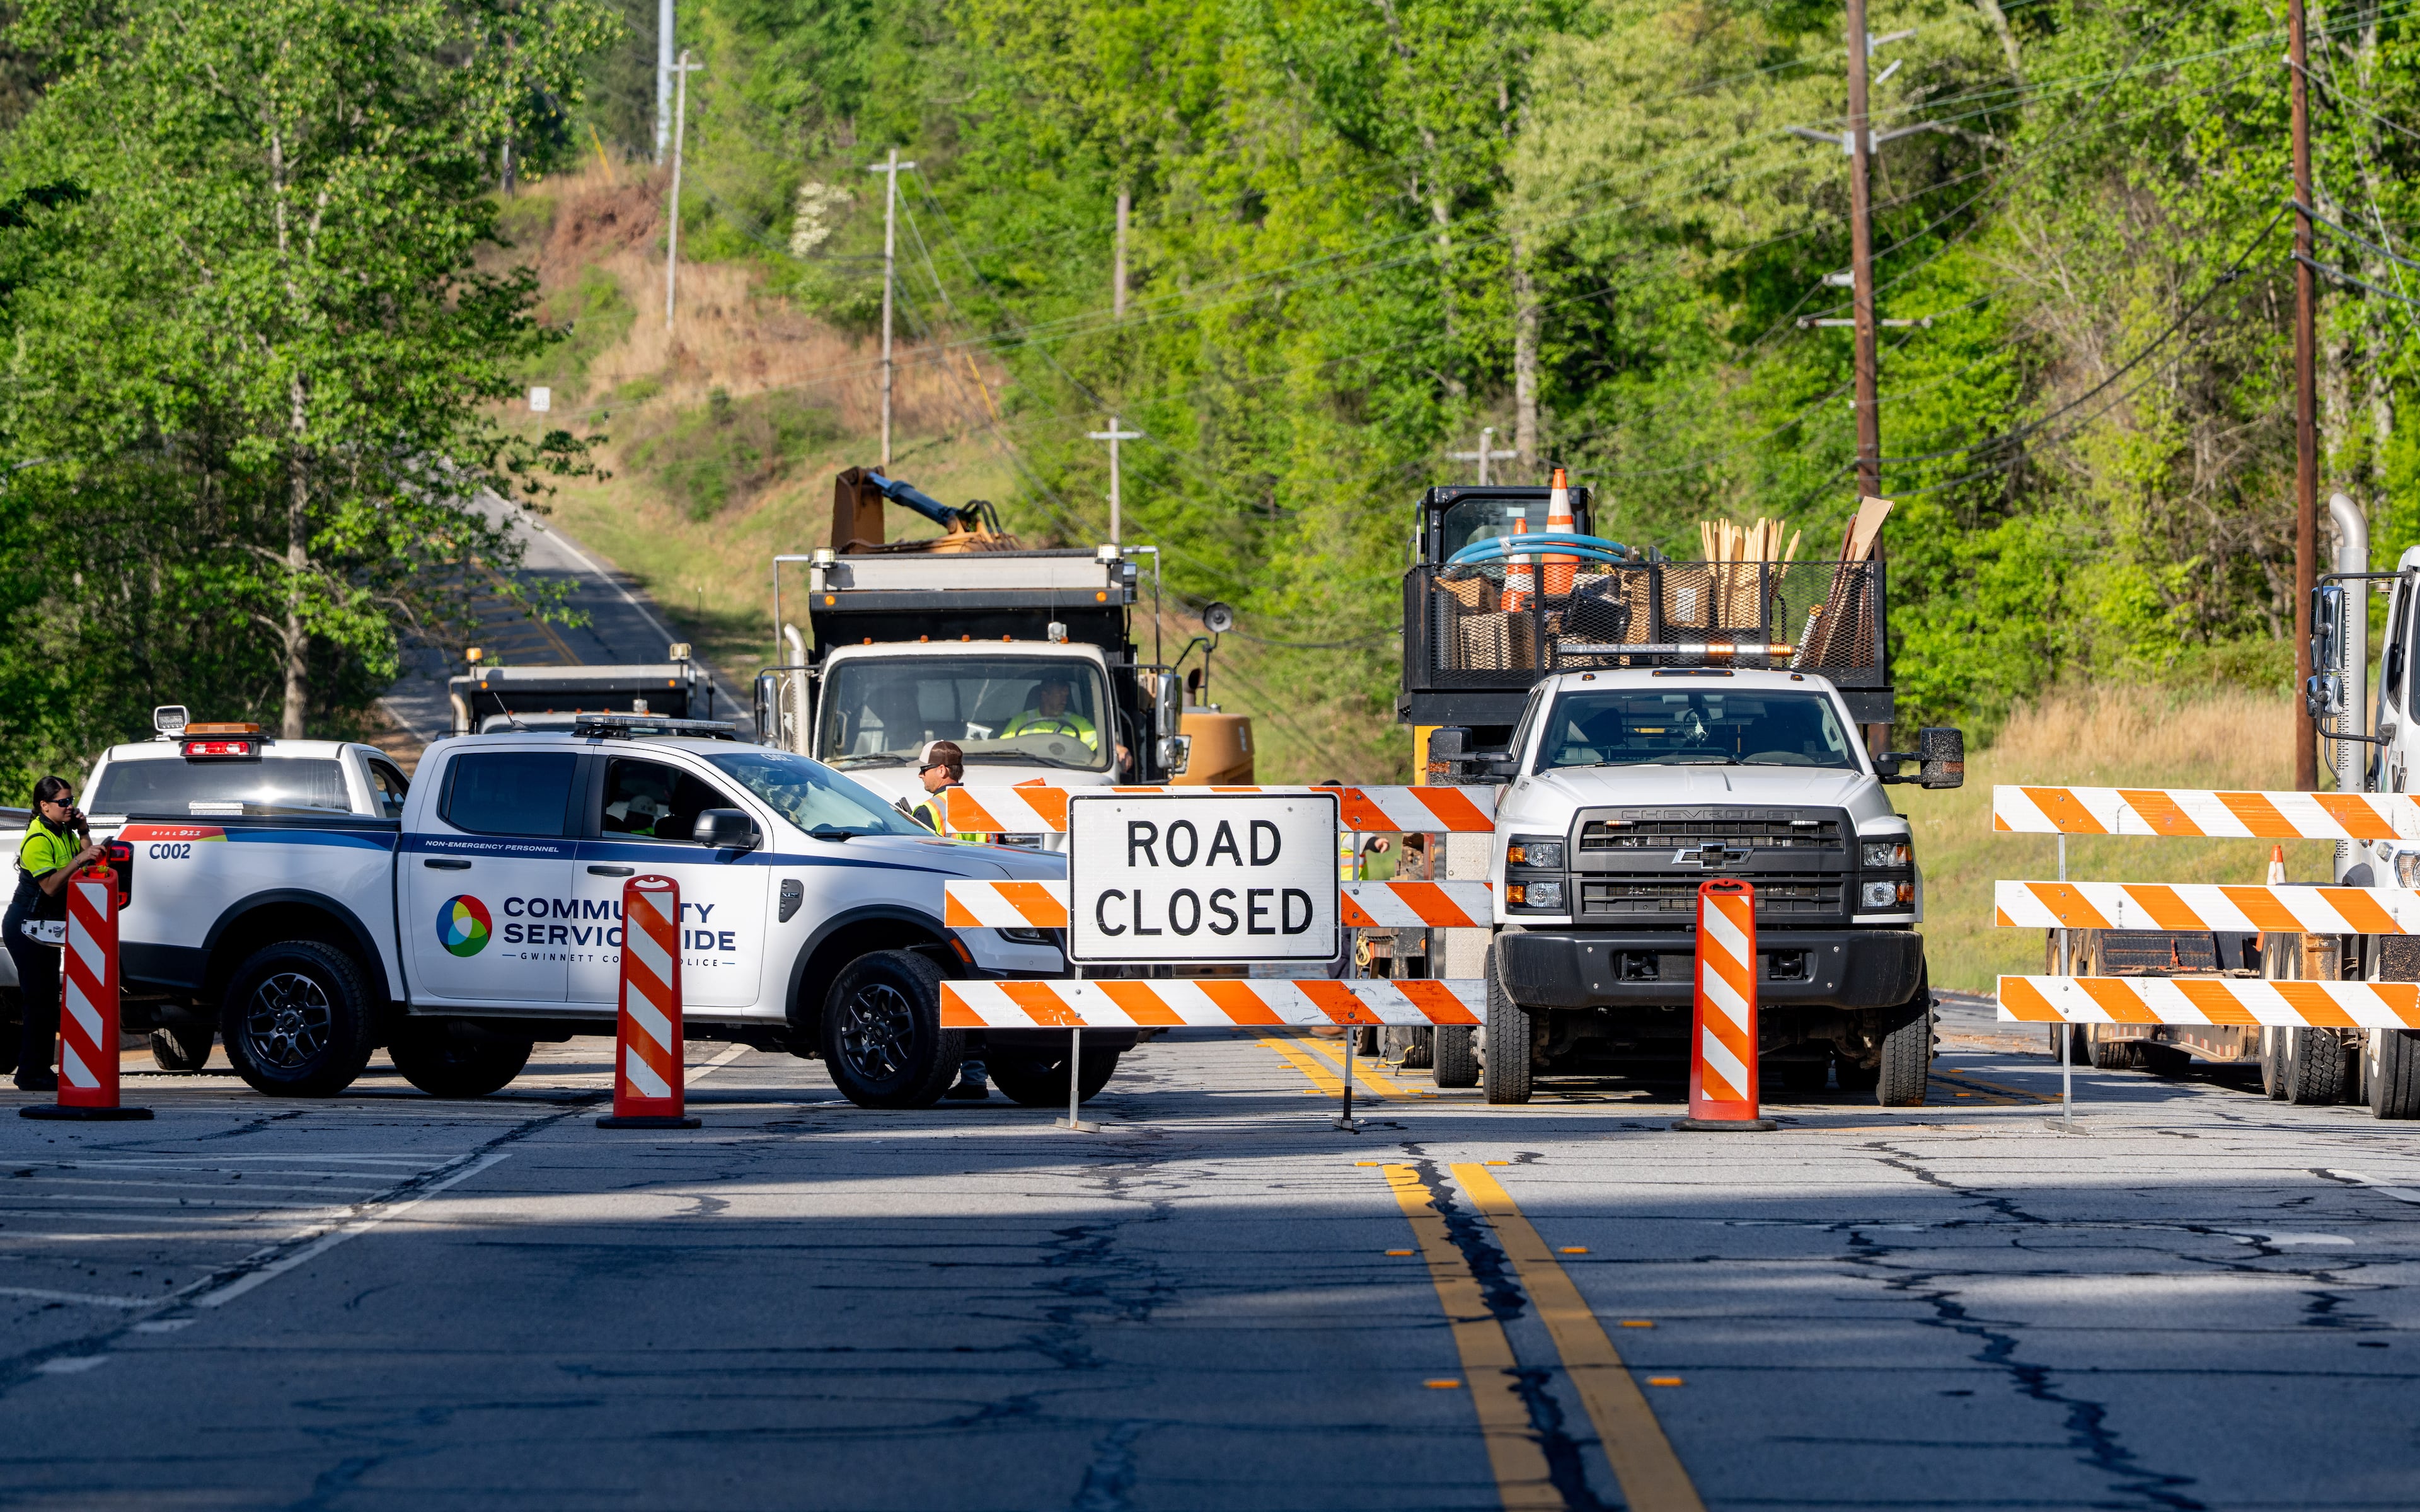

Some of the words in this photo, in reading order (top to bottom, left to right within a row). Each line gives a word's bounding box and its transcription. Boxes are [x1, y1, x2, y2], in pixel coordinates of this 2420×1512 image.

[1622, 810, 1804, 820] CHEVROLET
[149, 843, 192, 859] C002
[425, 840, 504, 850] NON-EMERGENCY
[1127, 820, 1281, 868] ROAD
[504, 896, 715, 924] COMMTY
[1096, 888, 1313, 937] CLOSED
[504, 923, 623, 947] SERVIC
[684, 929, 736, 951] IDE
[521, 952, 594, 962] GWINNETT
[680, 958, 718, 966] LICE
